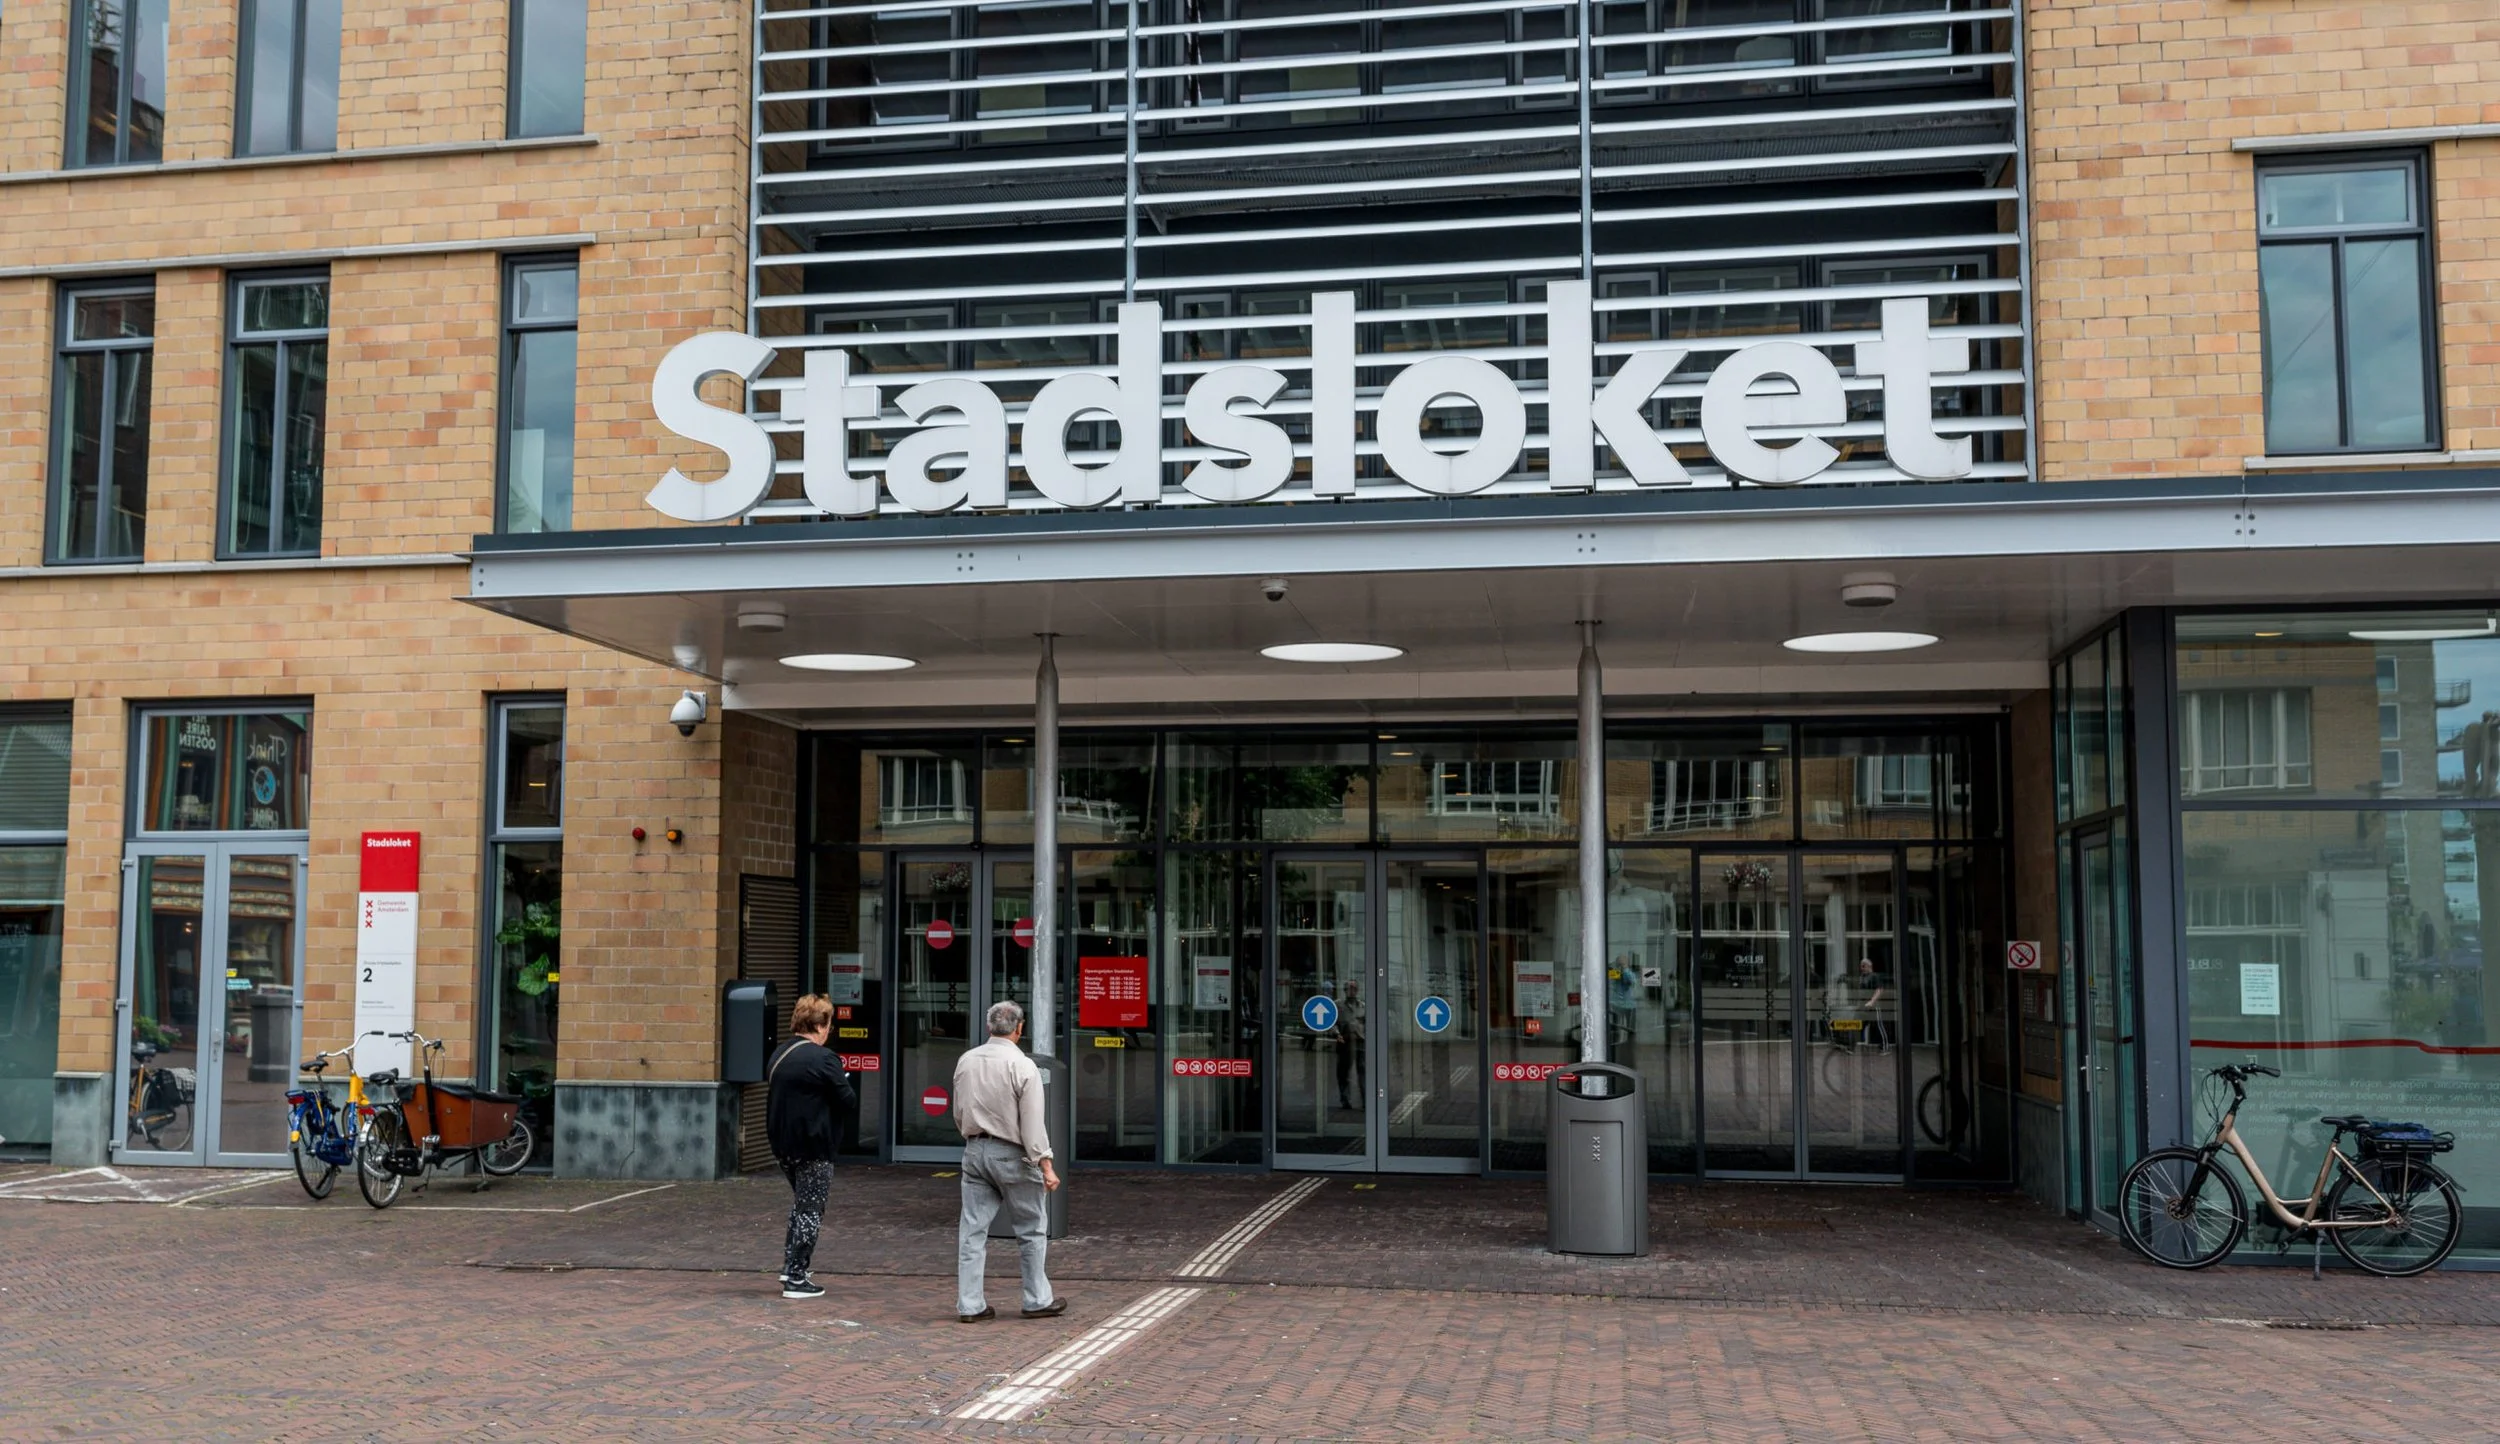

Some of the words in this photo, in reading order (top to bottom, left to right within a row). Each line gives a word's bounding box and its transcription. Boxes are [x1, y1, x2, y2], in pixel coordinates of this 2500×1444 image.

[645, 280, 1973, 522] Stadsloket
[366, 838, 412, 847] Stadsloket
[363, 967, 373, 983] 2
